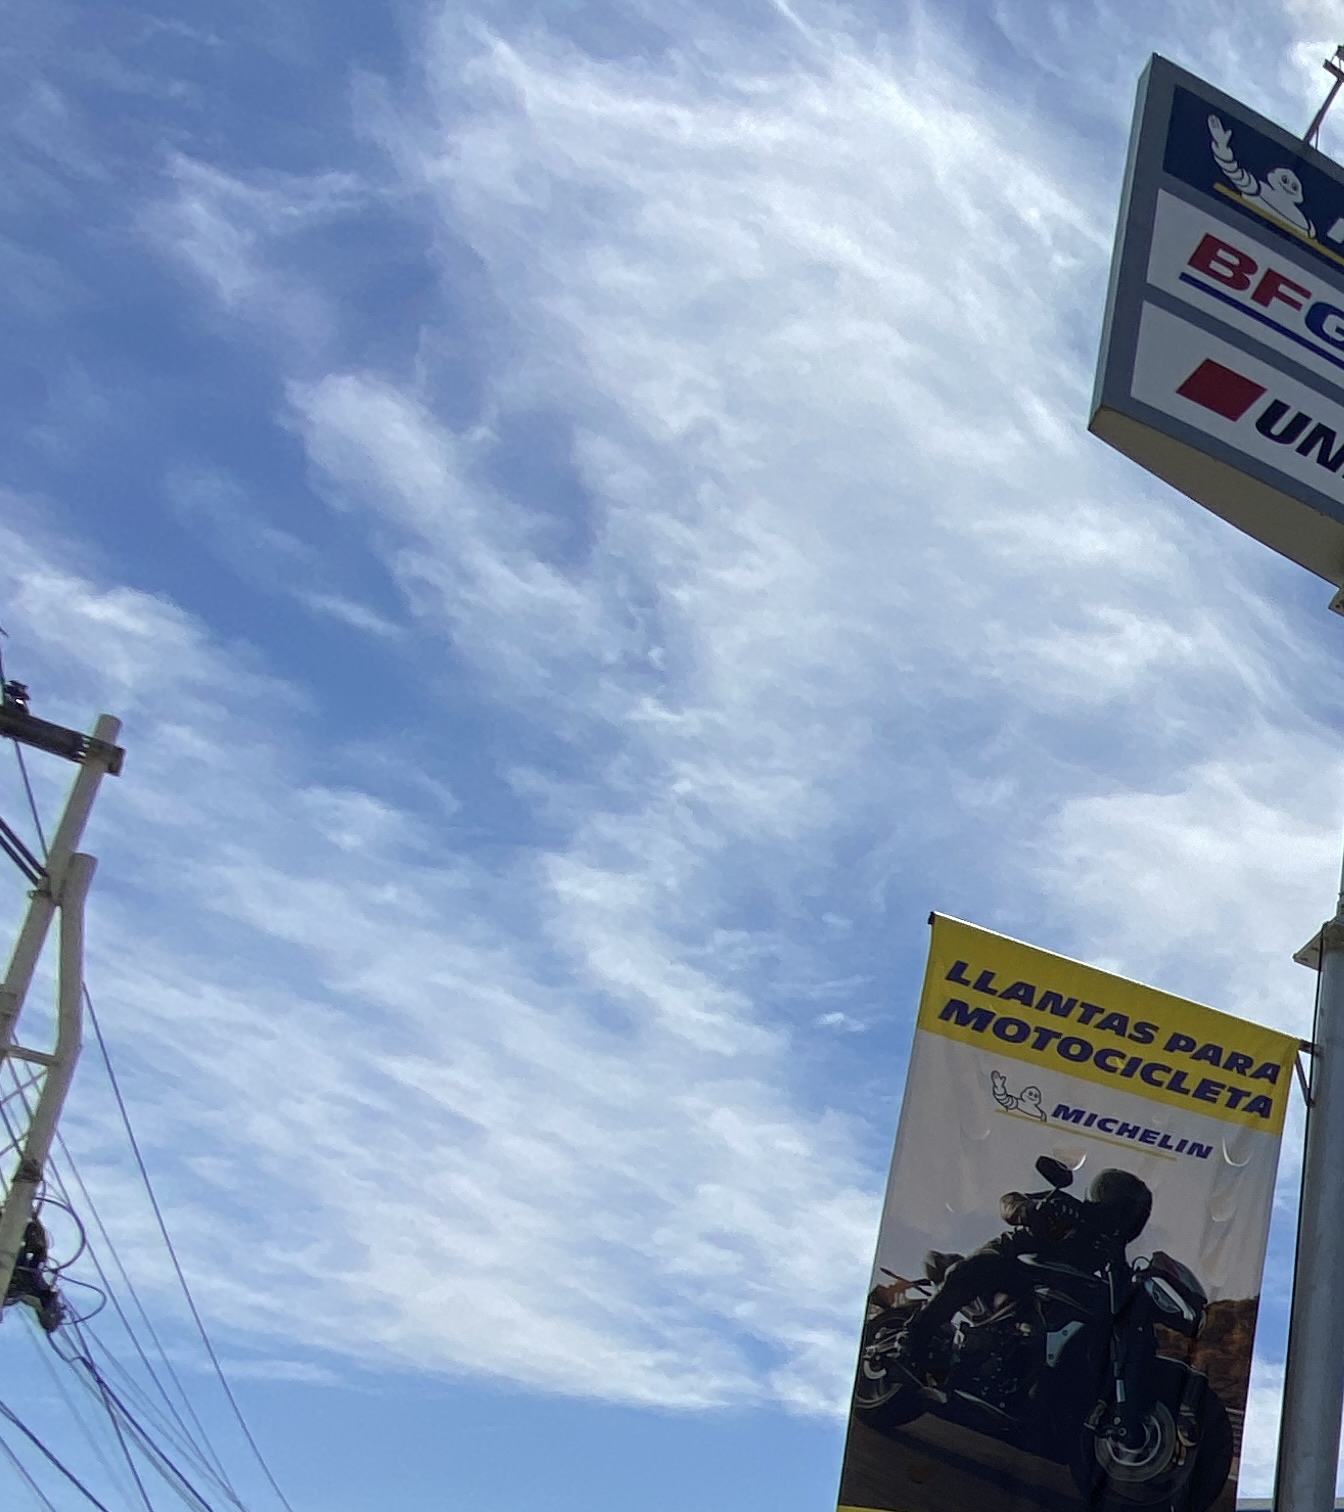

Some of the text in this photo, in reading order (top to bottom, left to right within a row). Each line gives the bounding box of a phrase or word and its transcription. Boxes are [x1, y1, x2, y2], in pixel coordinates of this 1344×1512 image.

[938, 998, 1273, 1119] MOTOCICLETA
[945, 960, 1282, 1084] LLANTAS PARA
[1050, 1103, 1213, 1160] MICHELIN
